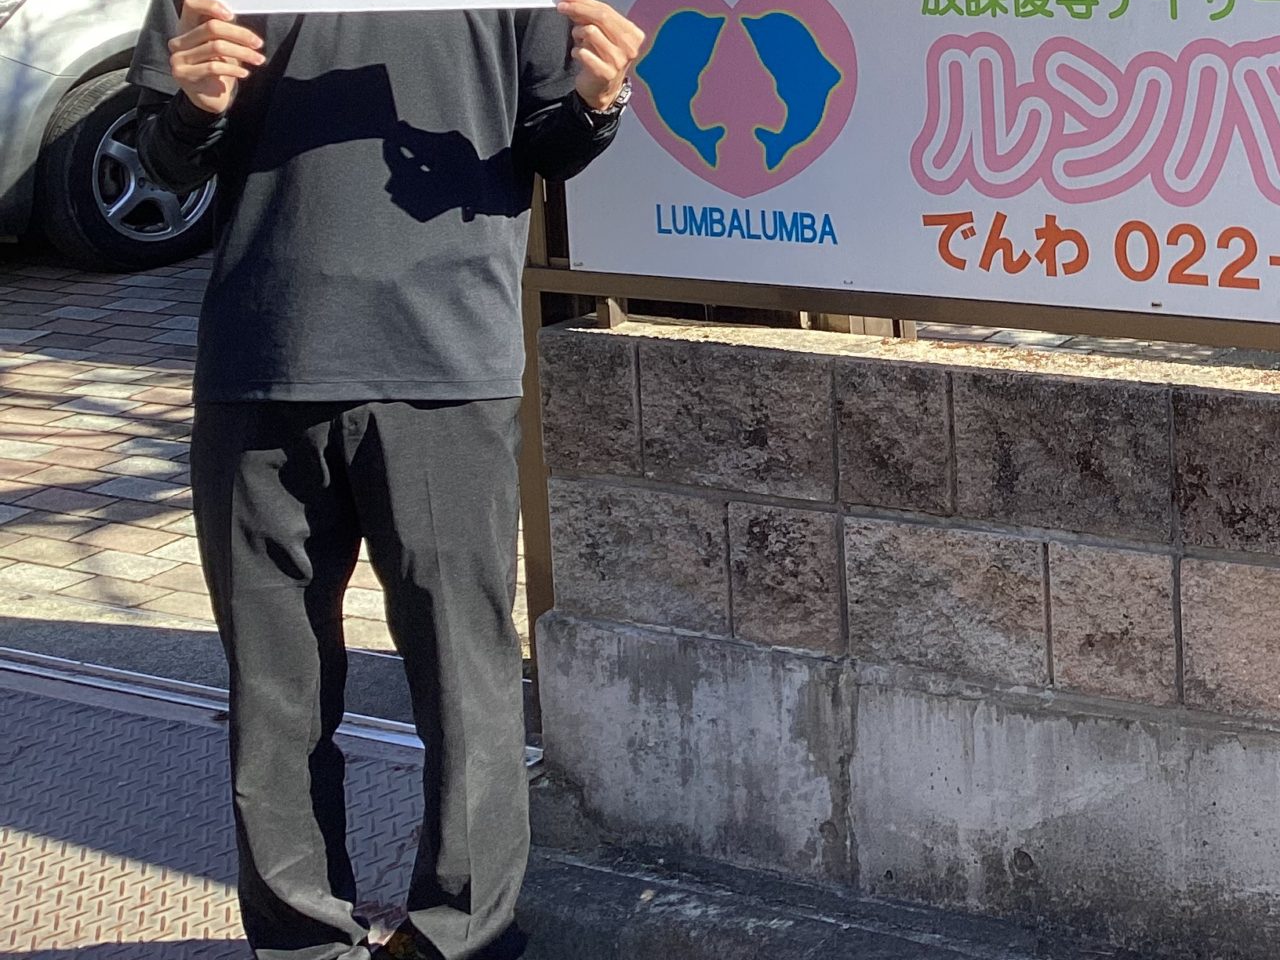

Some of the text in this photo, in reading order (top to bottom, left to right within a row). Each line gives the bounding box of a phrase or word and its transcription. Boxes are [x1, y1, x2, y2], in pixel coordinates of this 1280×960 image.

[656, 203, 838, 245] LUMBALUMBA
[922, 211, 1089, 278] でんわ
